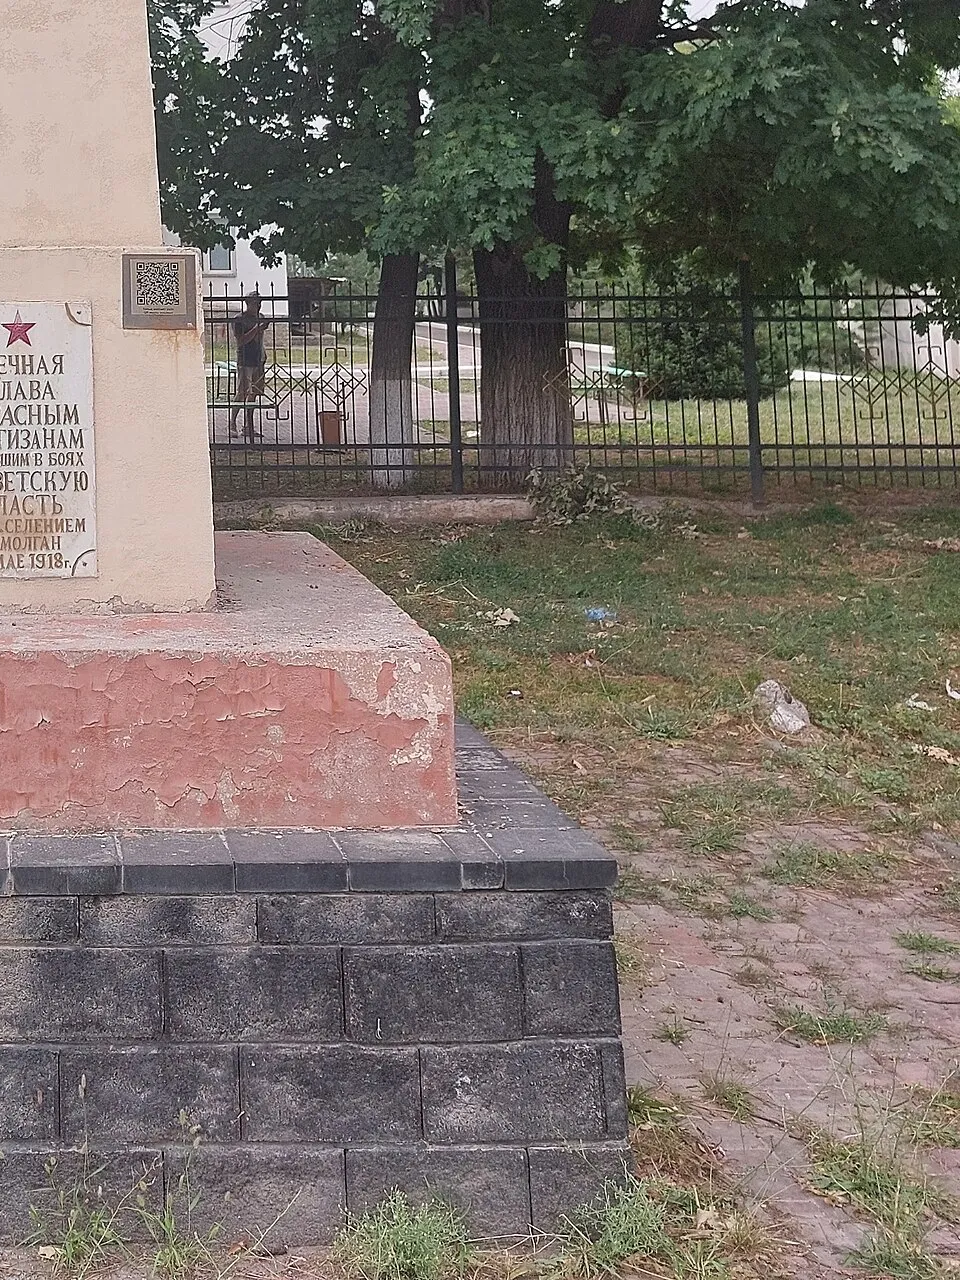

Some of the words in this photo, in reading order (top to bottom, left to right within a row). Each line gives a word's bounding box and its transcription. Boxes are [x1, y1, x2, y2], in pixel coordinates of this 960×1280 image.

[34, 452, 43, 467] В
[48, 451, 85, 467] БОЯХ
[4, 517, 87, 534] СЕЛЕНИЕМ
